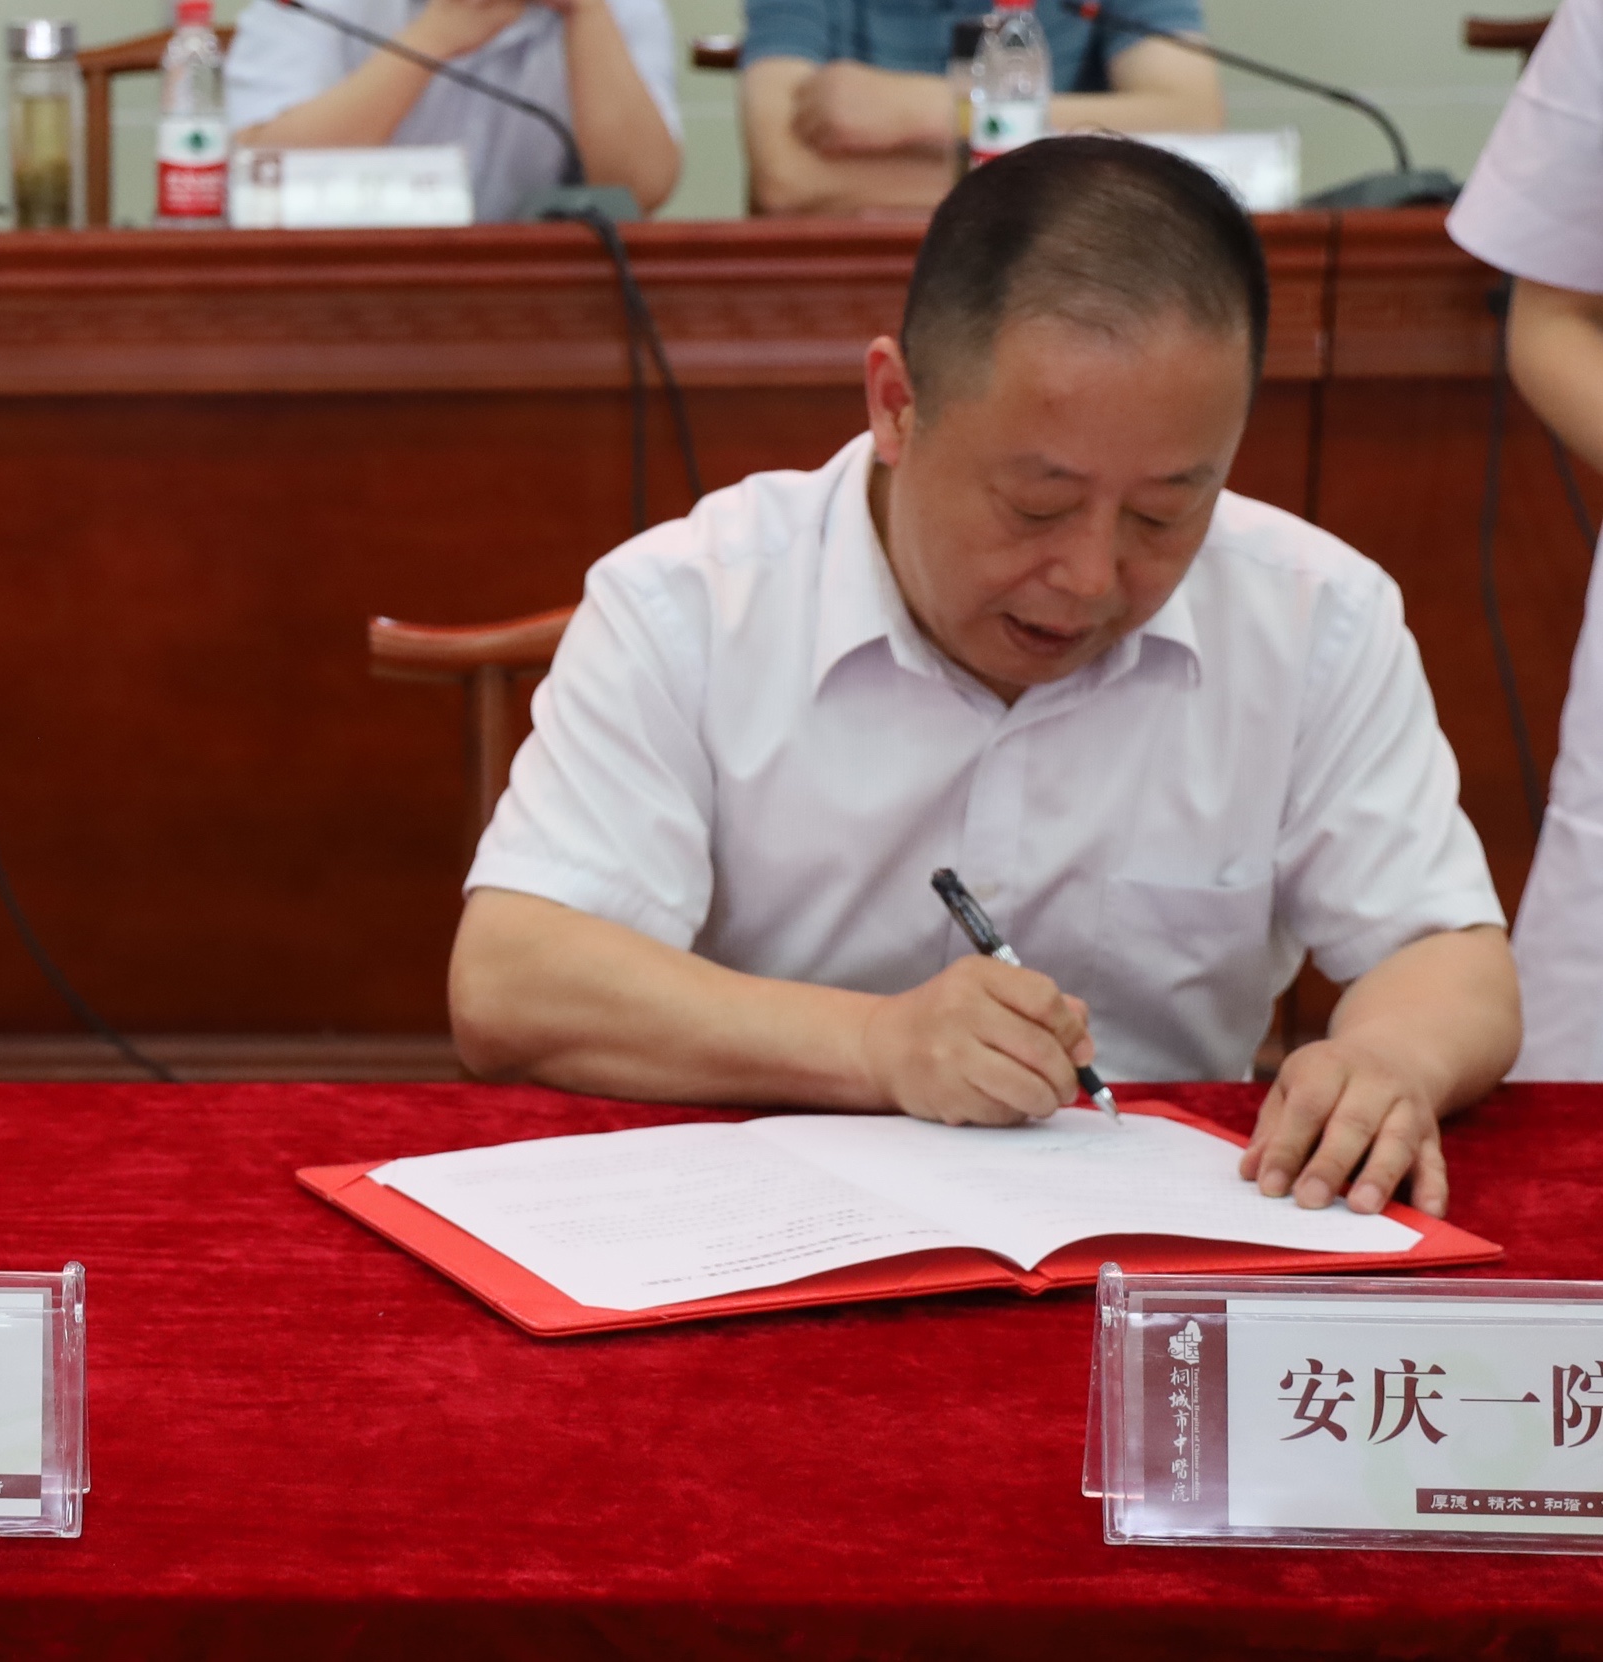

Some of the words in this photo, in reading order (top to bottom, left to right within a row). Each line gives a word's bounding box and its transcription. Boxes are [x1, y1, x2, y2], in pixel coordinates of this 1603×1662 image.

[1278, 1358, 1603, 1448] 安庆一院
[1430, 1494, 1603, 1512] 厚德•精术•和谐•
